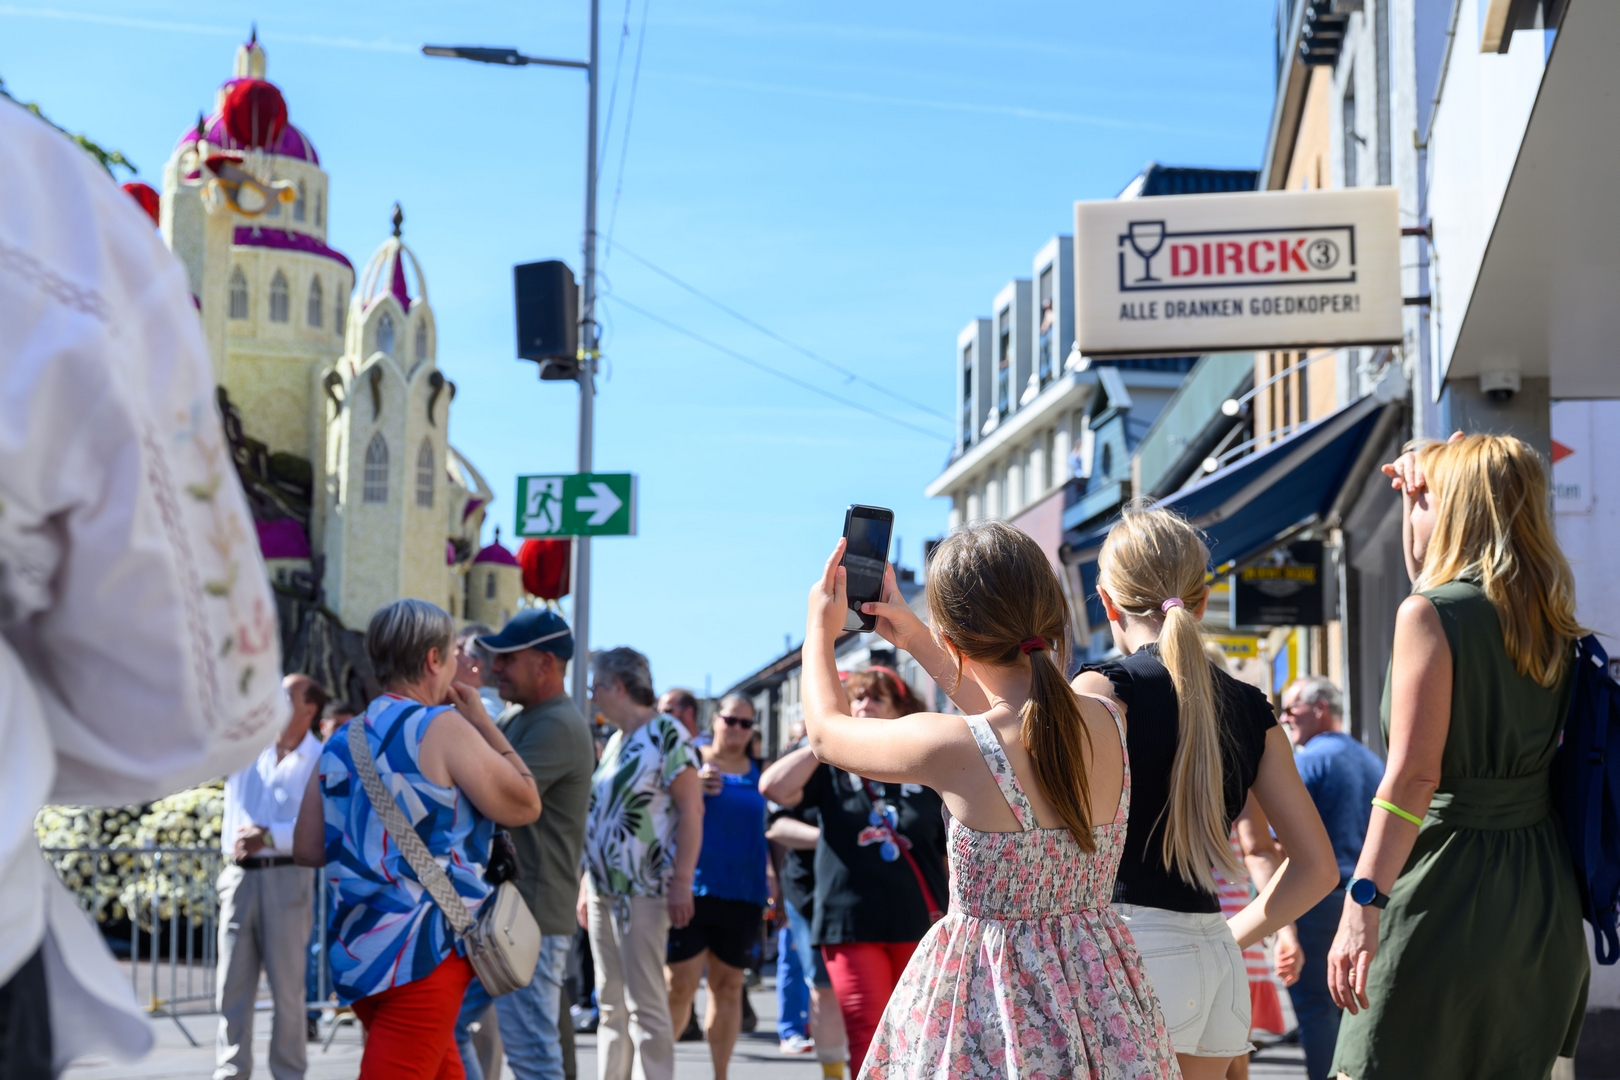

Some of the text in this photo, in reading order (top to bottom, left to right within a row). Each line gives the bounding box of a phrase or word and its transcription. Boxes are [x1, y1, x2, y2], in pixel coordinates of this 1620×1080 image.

[1170, 238, 1309, 277] DIRCK
[1120, 294, 1360, 320] ALLE DRANKEN GOEDKOPER!
